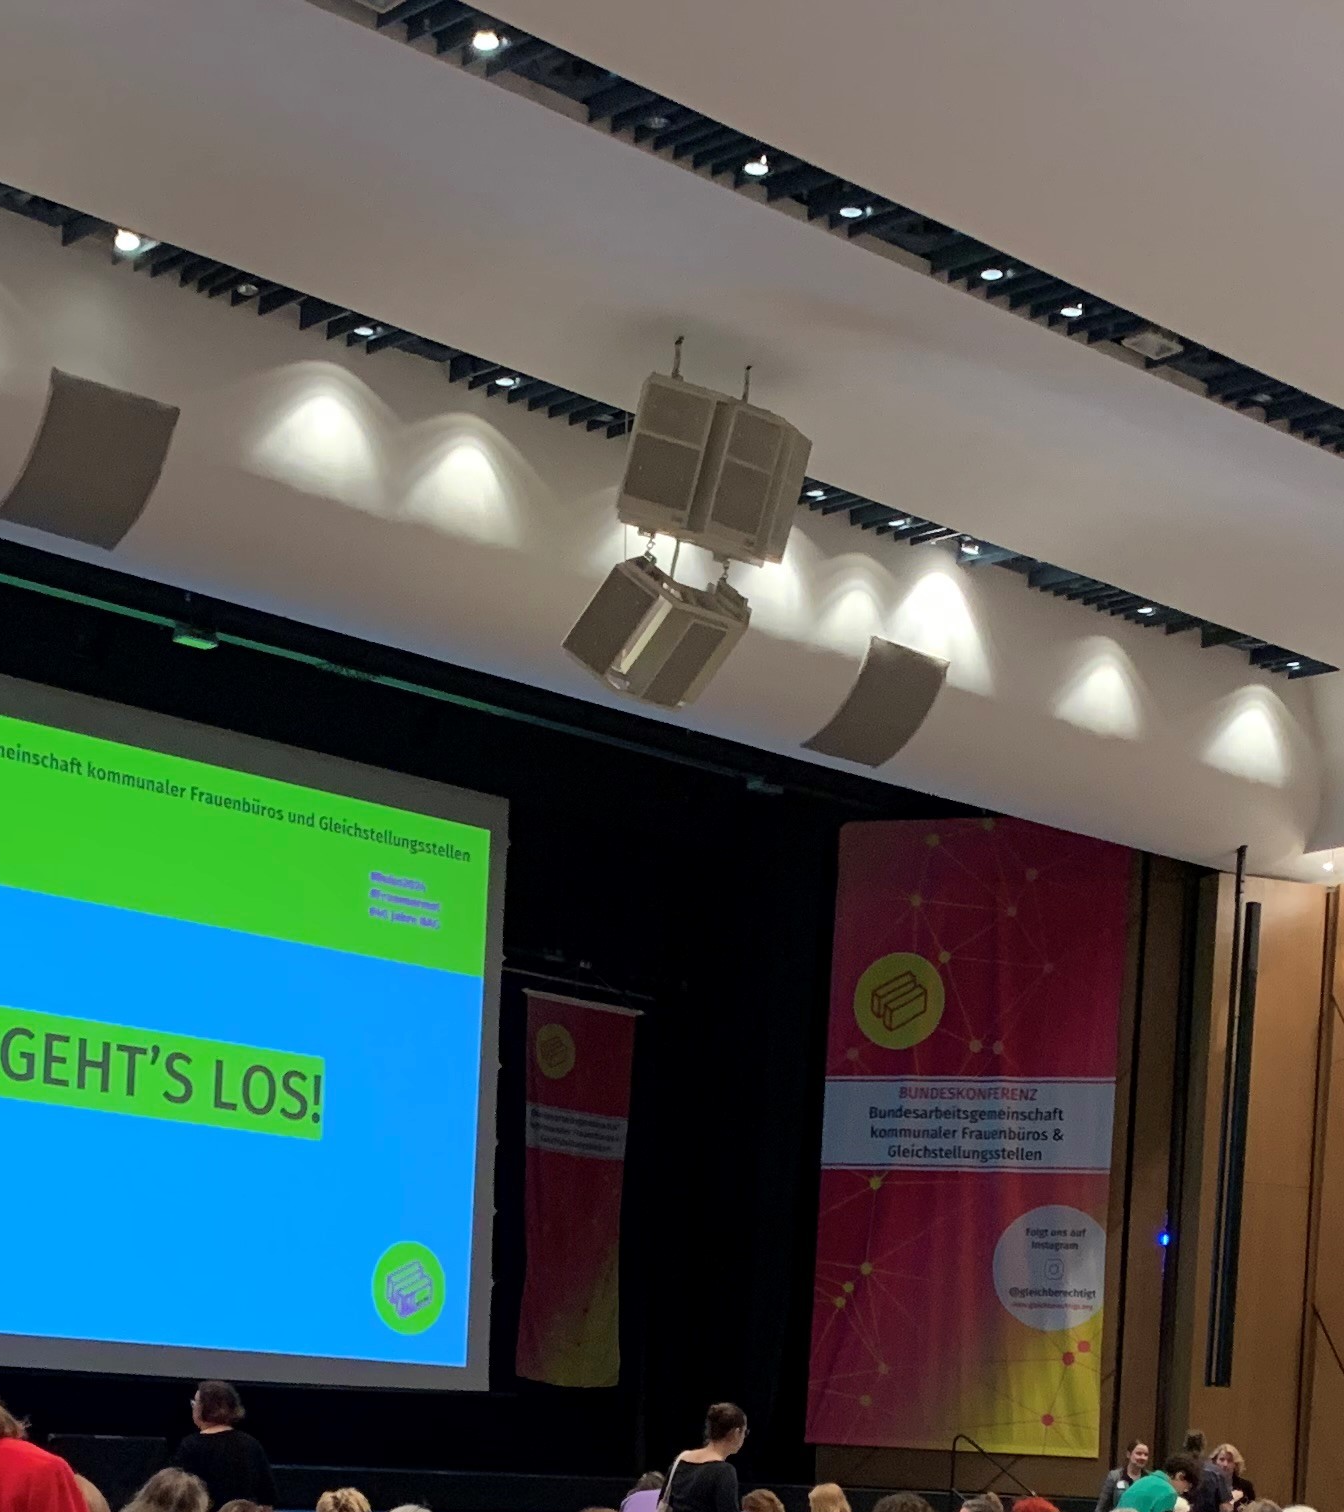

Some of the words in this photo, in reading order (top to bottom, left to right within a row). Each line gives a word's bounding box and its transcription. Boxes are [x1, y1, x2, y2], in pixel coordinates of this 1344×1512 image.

[87, 761, 186, 799] kommunaler
[190, 786, 284, 821] Frauenbüros
[287, 809, 315, 829] und
[318, 815, 471, 862] Gleichstellungsstellen
[0, 1026, 193, 1104] GEHT'S
[212, 1059, 322, 1125] LOS!
[899, 1087, 1038, 1101] BUNDESKONFERENZ
[869, 1106, 1064, 1123] Bundesarbeitsgemeinschaft
[870, 1126, 957, 1139] kommunaler
[962, 1127, 1048, 1141] Frauenbüros
[1053, 1129, 1064, 1141] &
[888, 1144, 1042, 1163] Gleichstellungsstellen
